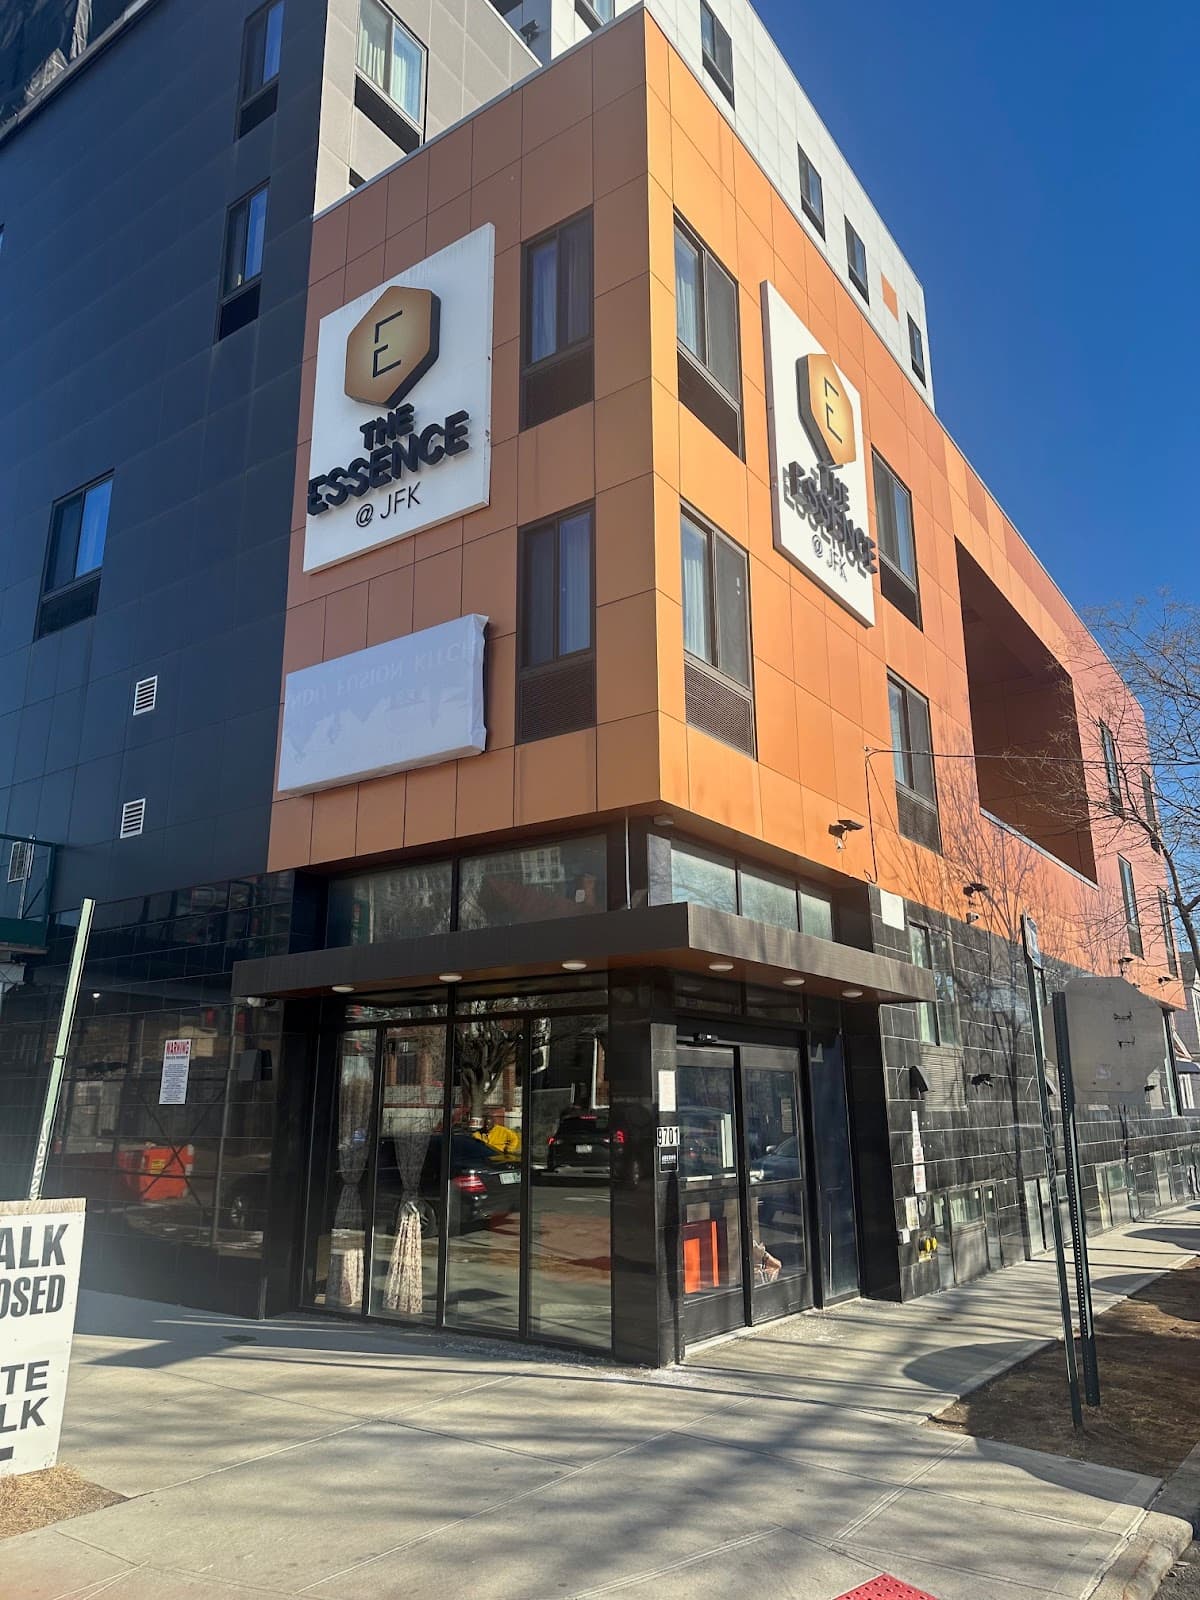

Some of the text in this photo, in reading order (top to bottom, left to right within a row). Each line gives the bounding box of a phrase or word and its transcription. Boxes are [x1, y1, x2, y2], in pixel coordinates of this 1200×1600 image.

[359, 403, 415, 451] THE
[307, 409, 470, 516] ESSENCE
[355, 481, 422, 528] @ JFK
[826, 547, 848, 582] JFK
[657, 1127, 678, 1145] 9701
